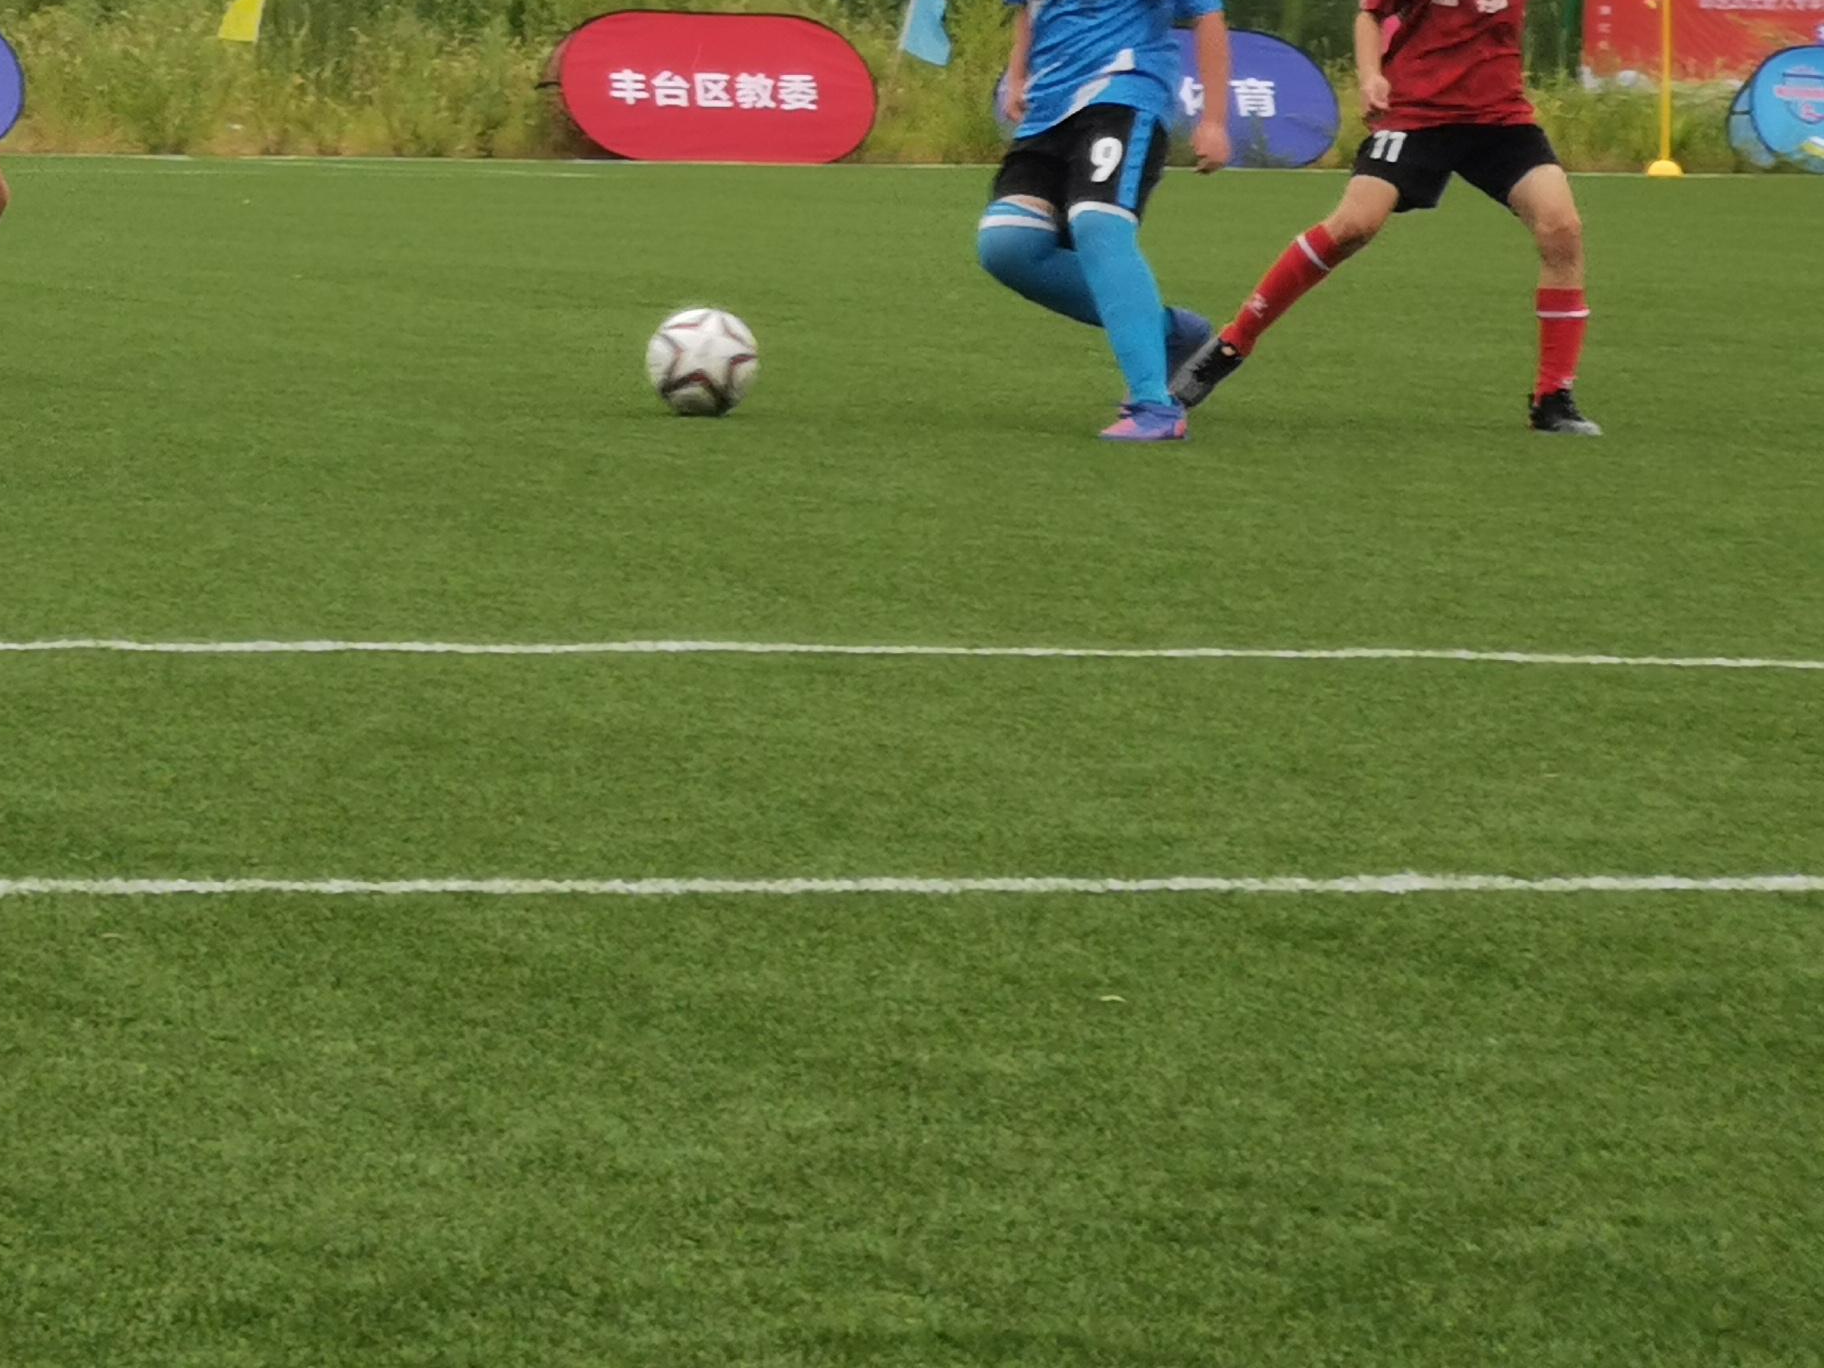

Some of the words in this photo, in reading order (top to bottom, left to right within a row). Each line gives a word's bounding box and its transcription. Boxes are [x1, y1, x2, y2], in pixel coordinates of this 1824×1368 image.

[608, 68, 819, 111] 丰台区教委
[1090, 136, 1123, 183] 9
[1370, 129, 1408, 163] 11
